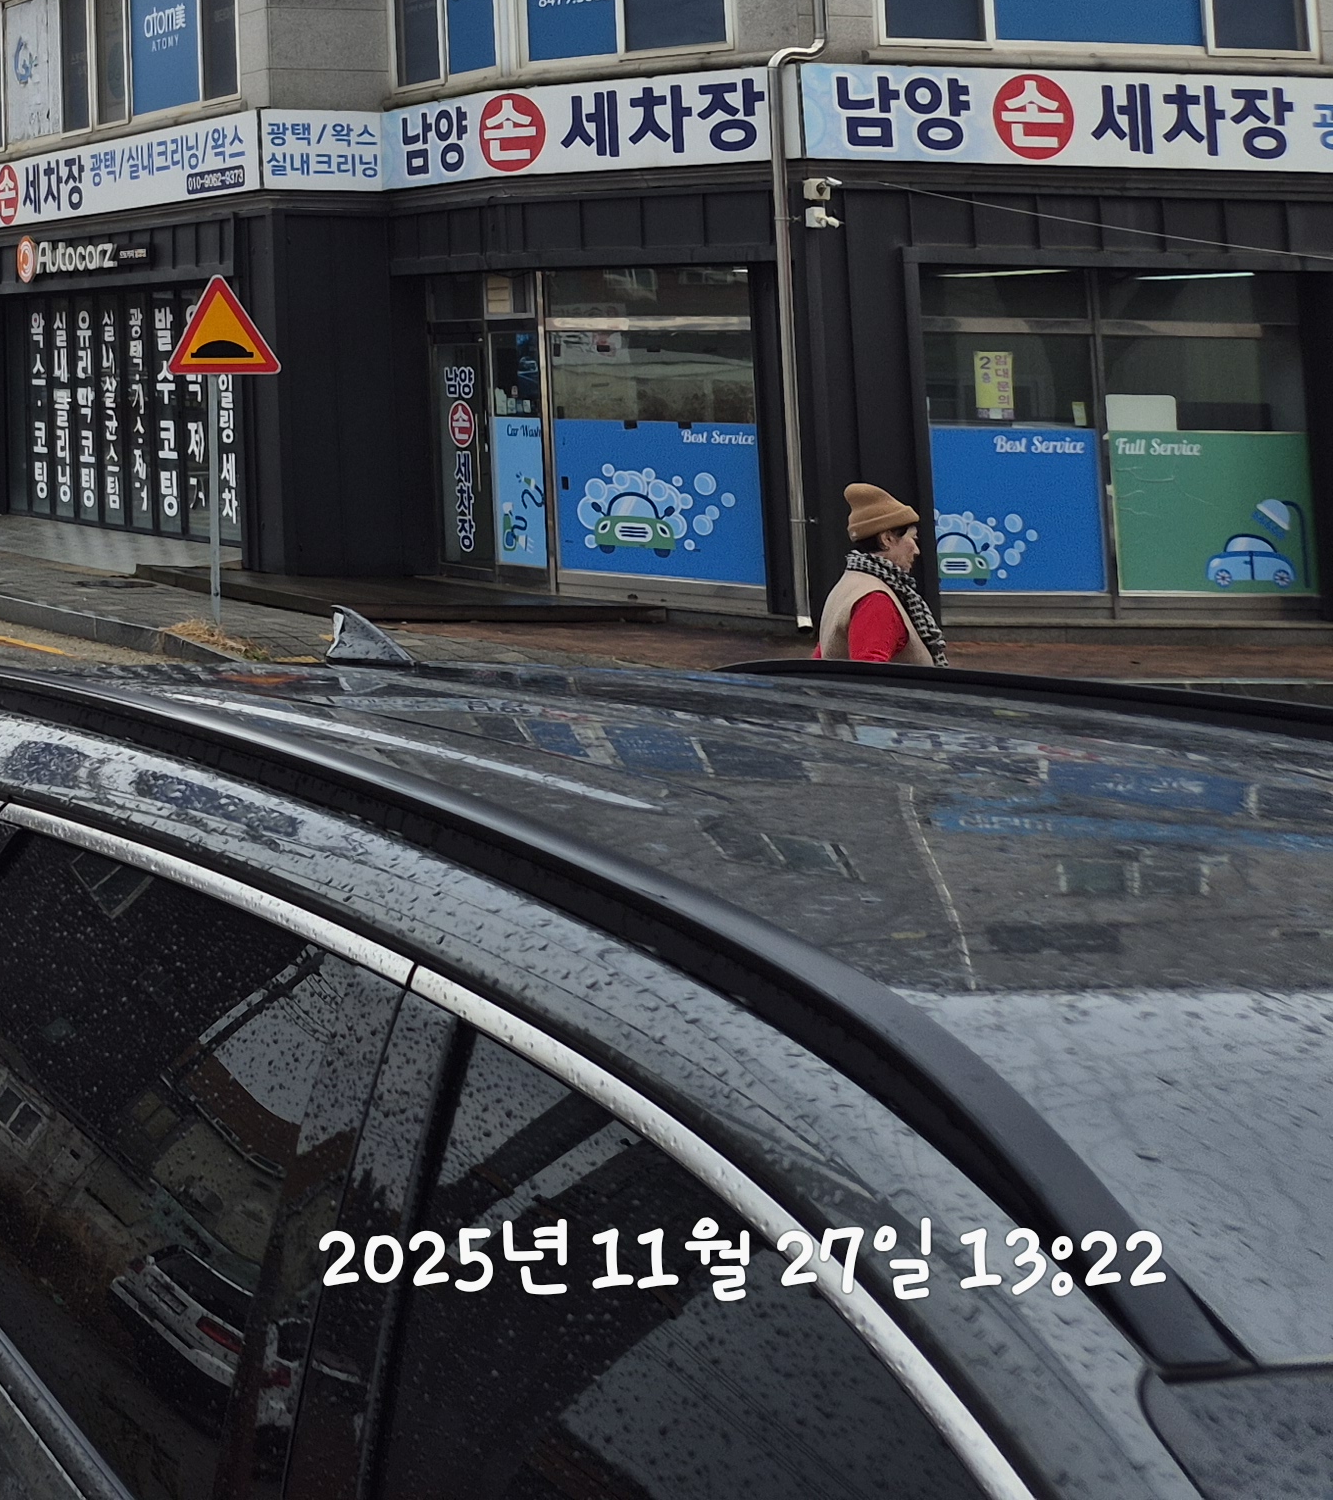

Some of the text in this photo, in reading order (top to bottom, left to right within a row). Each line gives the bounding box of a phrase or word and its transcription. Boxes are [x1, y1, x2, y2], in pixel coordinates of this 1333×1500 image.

[151, 34, 179, 52] ATOMY
[401, 77, 765, 176] 남양 손 세차장
[835, 75, 971, 151] 남양
[1000, 79, 1064, 150] 손
[1091, 83, 1295, 159] 세차장
[266, 152, 379, 179] 실내크리닝
[23, 154, 85, 214] 세차장
[36, 242, 117, 274] Autocarz
[995, 355, 1009, 405] 임대문의
[680, 429, 755, 446] Best Service
[993, 435, 1085, 455] Best Service
[1115, 437, 1201, 457] Full Service
[445, 366, 477, 553] 남양 손 세차장
